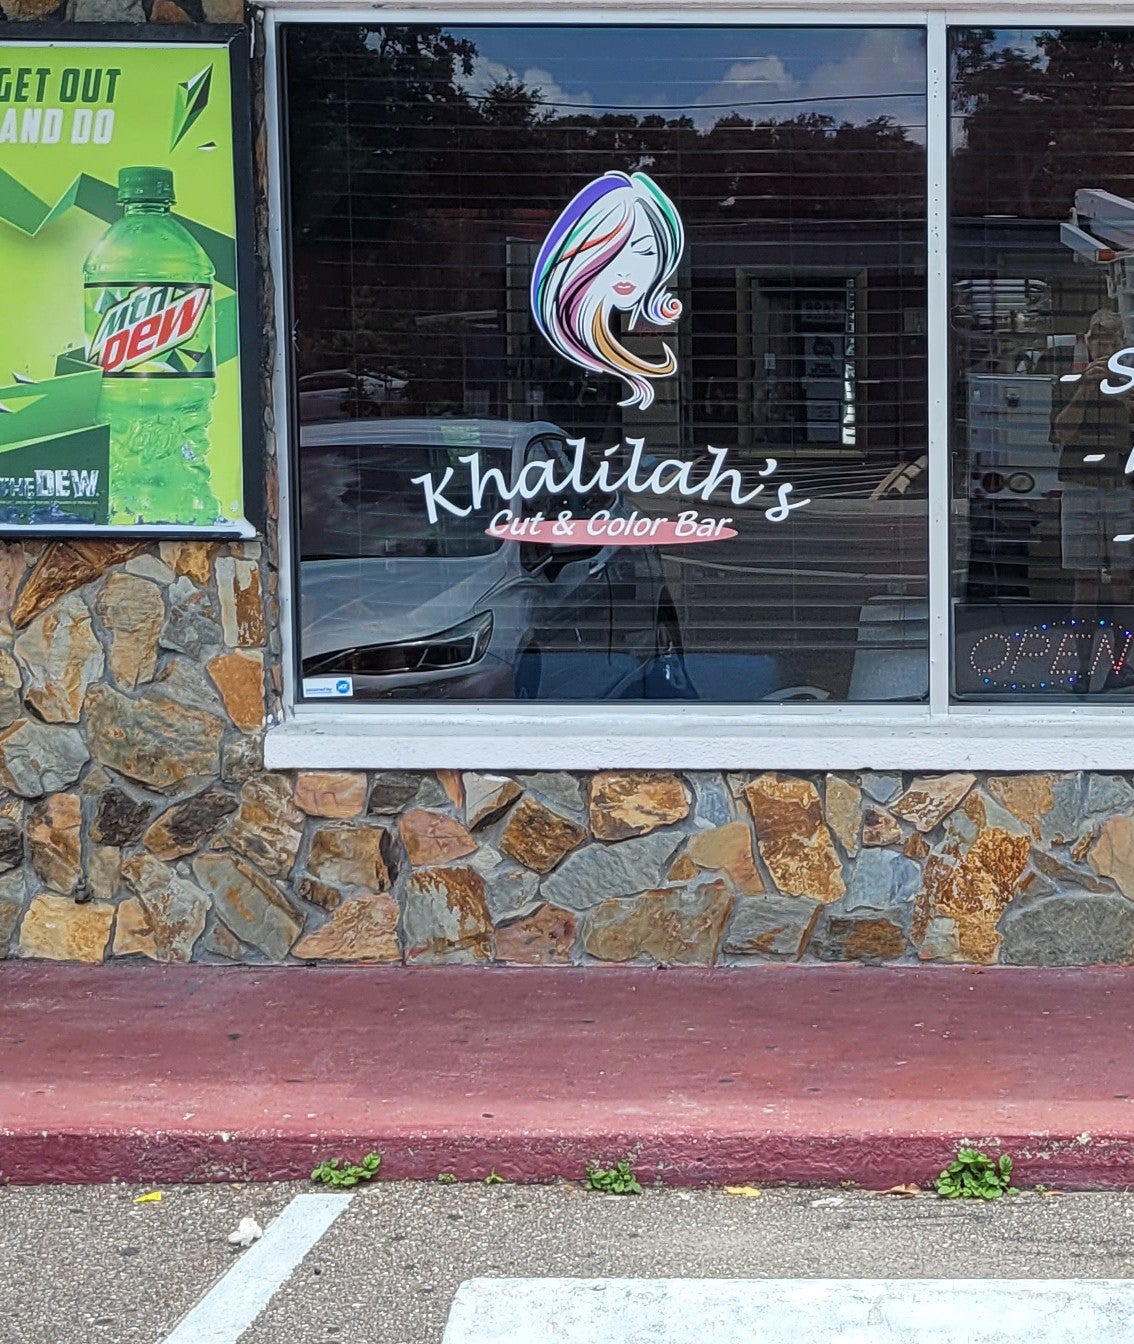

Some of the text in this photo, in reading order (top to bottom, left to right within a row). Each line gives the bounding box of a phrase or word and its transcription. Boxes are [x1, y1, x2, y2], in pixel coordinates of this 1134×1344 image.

[0, 68, 121, 104] GET OUT
[0, 108, 115, 144] AND DO
[410, 436, 811, 525] Khalilah's
[489, 510, 734, 538] Cut & Color Bar
[970, 633, 1133, 675] OPEN
